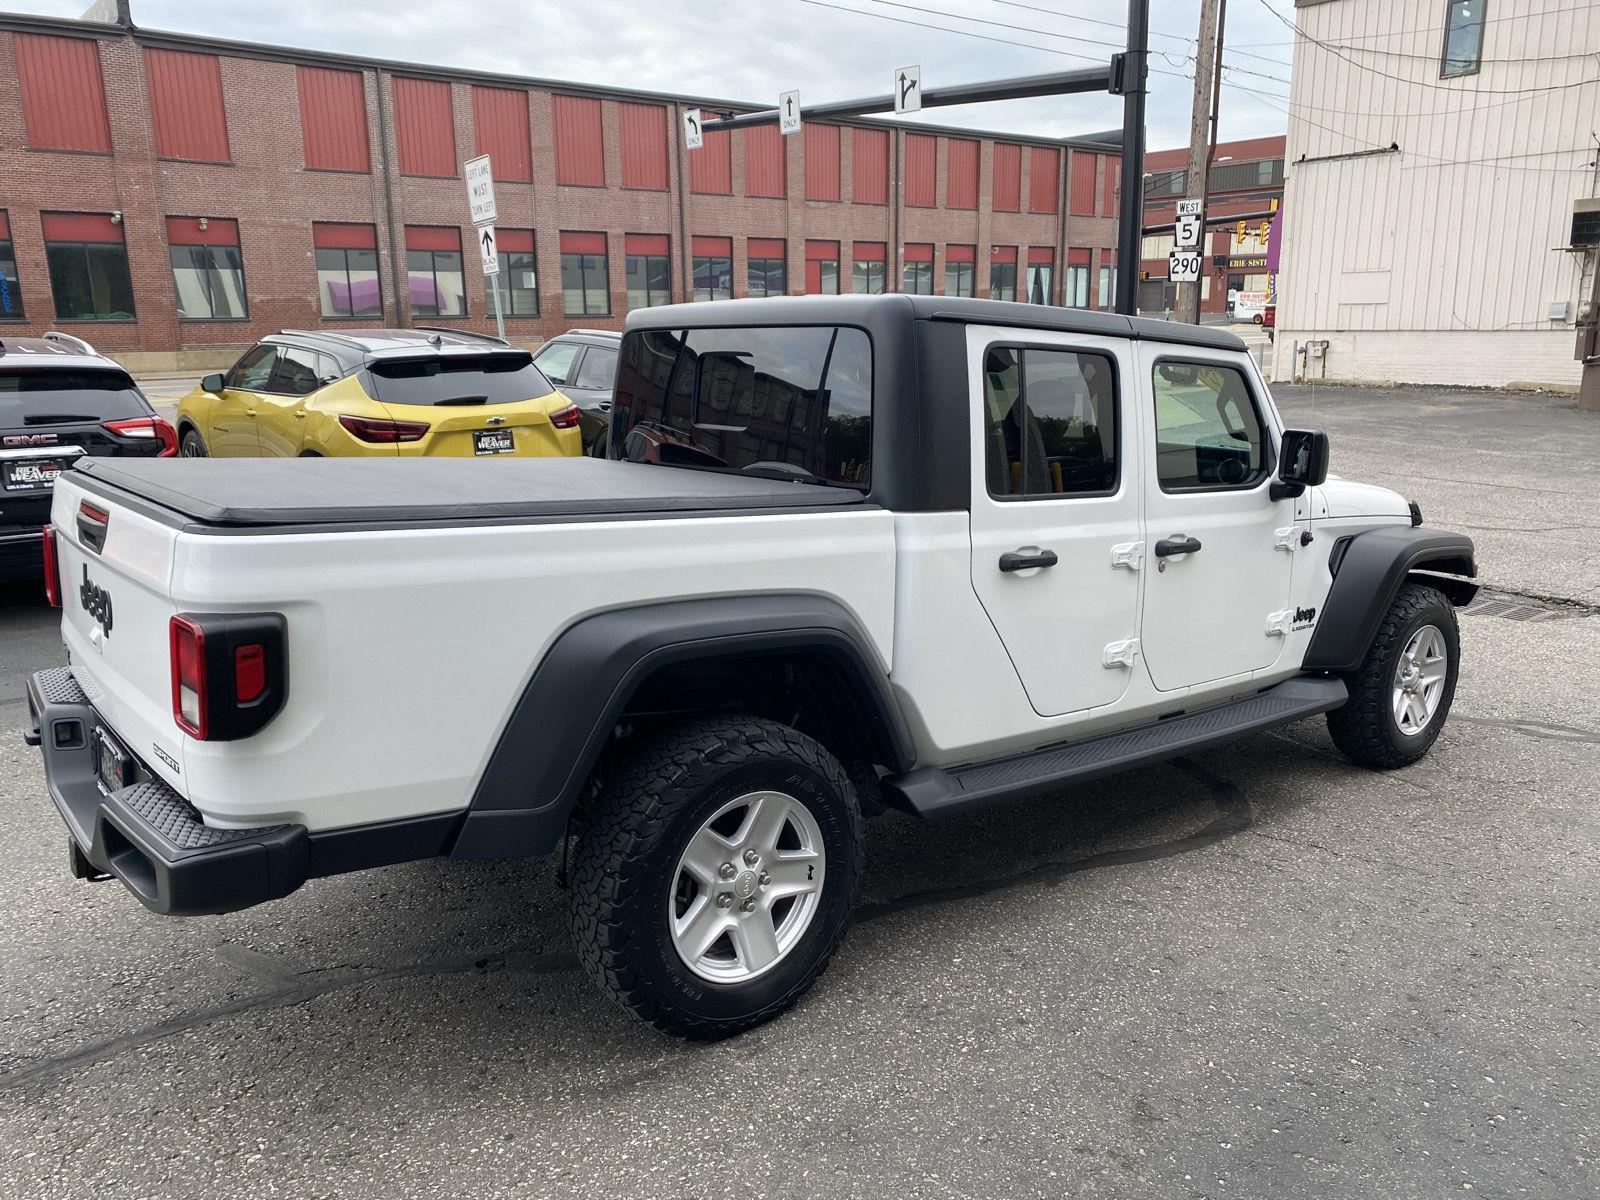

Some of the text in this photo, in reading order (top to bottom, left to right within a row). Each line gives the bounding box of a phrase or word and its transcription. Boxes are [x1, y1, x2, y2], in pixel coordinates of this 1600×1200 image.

[784, 120, 796, 128] ONLY
[689, 136, 700, 146] ONLY
[468, 164, 489, 180] LEFT LANE
[473, 182, 487, 197] MUST
[472, 201, 493, 216] TURN LEFT
[1180, 202, 1199, 212] WEST
[1182, 223, 1193, 240] 5
[1172, 257, 1199, 274] 290
[3, 434, 58, 445] GMC
[478, 440, 511, 449] WEAVER
[10, 470, 62, 482] WEAVER
[15, 465, 40, 474] RICK
[79, 562, 113, 639] Jeep
[1293, 606, 1316, 623] Jeep
